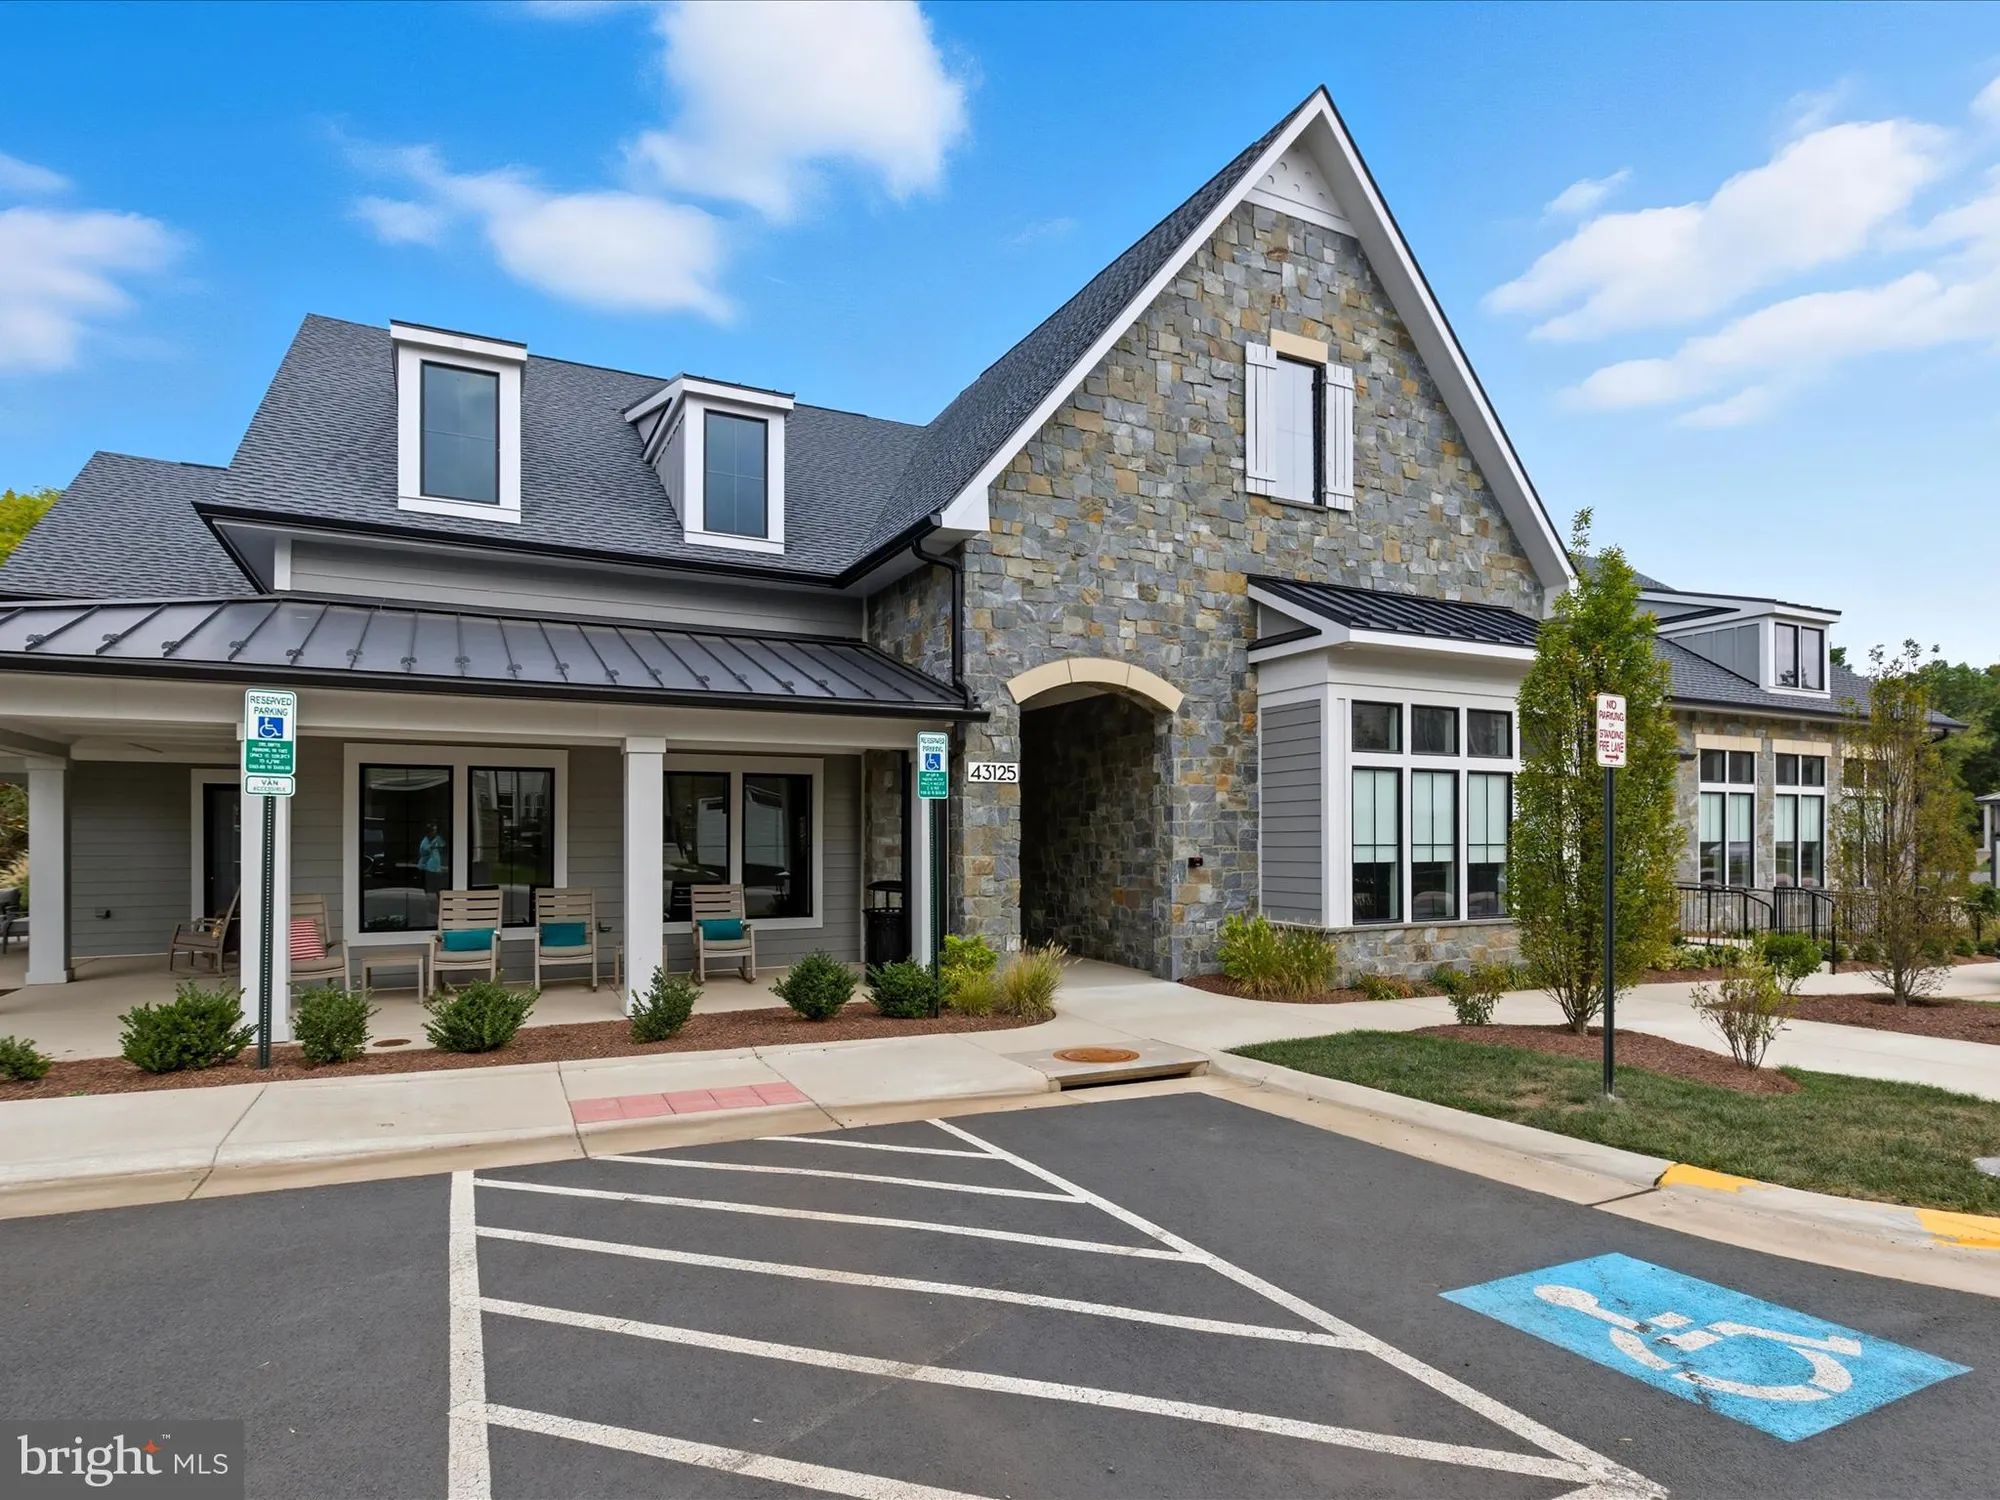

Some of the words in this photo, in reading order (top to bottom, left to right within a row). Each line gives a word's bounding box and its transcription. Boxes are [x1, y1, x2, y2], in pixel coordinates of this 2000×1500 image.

[250, 695, 292, 706] RESERVED
[1606, 700, 1617, 710] NO
[253, 706, 288, 716] PARKING
[1599, 710, 1624, 721] PARKING
[1600, 729, 1624, 740] STANDING
[1611, 742, 1624, 753] LANE
[970, 764, 1017, 781] 43125
